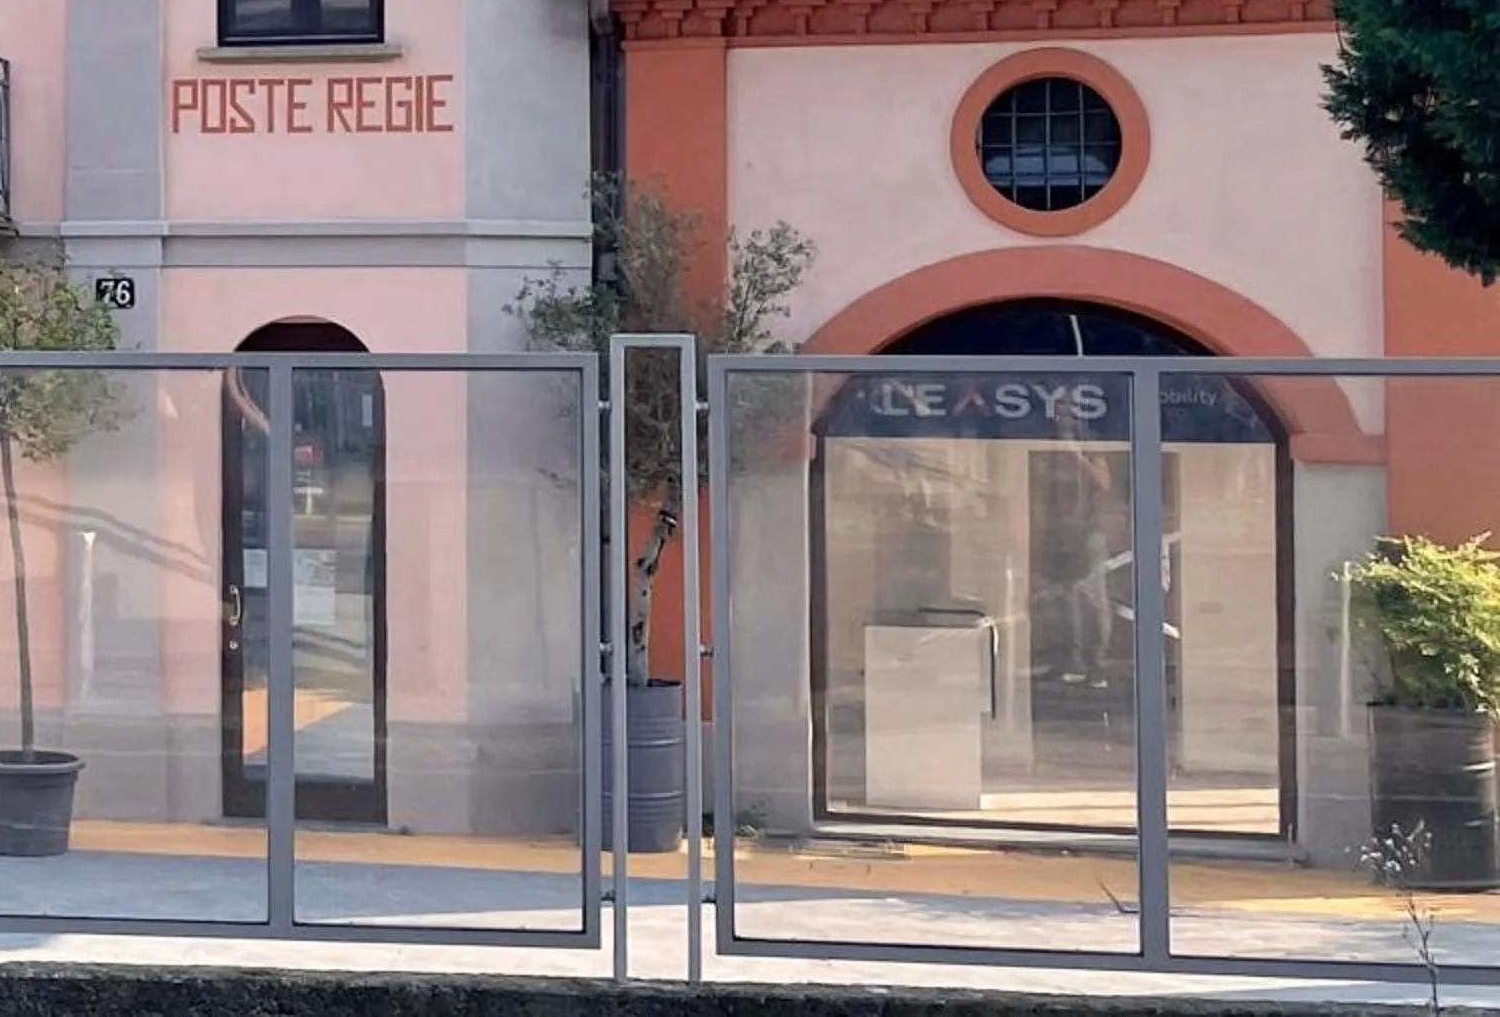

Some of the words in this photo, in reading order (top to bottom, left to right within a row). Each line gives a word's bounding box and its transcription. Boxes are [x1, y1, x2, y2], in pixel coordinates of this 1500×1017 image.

[172, 78, 313, 134] POSTE
[327, 74, 453, 133] REGIE
[100, 280, 131, 305] 76
[1159, 388, 1218, 407] obility
